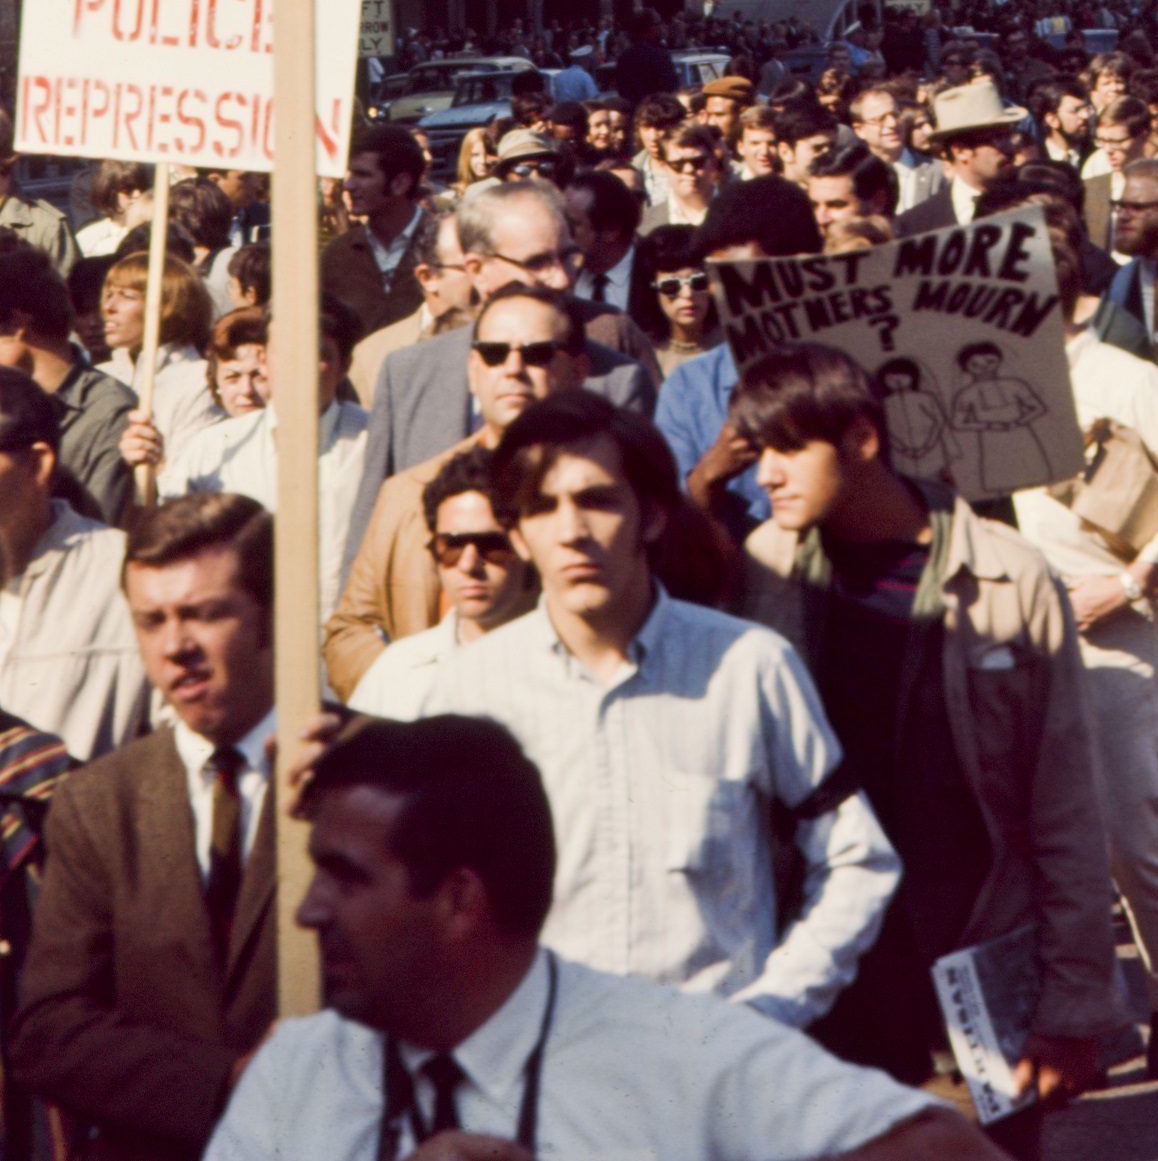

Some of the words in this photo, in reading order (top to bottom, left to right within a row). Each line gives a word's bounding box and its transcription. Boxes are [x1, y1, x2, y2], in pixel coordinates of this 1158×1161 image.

[21, 75, 342, 162] REPRESSIN
[718, 253, 873, 317] MUST
[893, 220, 1037, 283] MORE
[868, 314, 901, 353] ?
[912, 282, 1062, 338] MOURN
